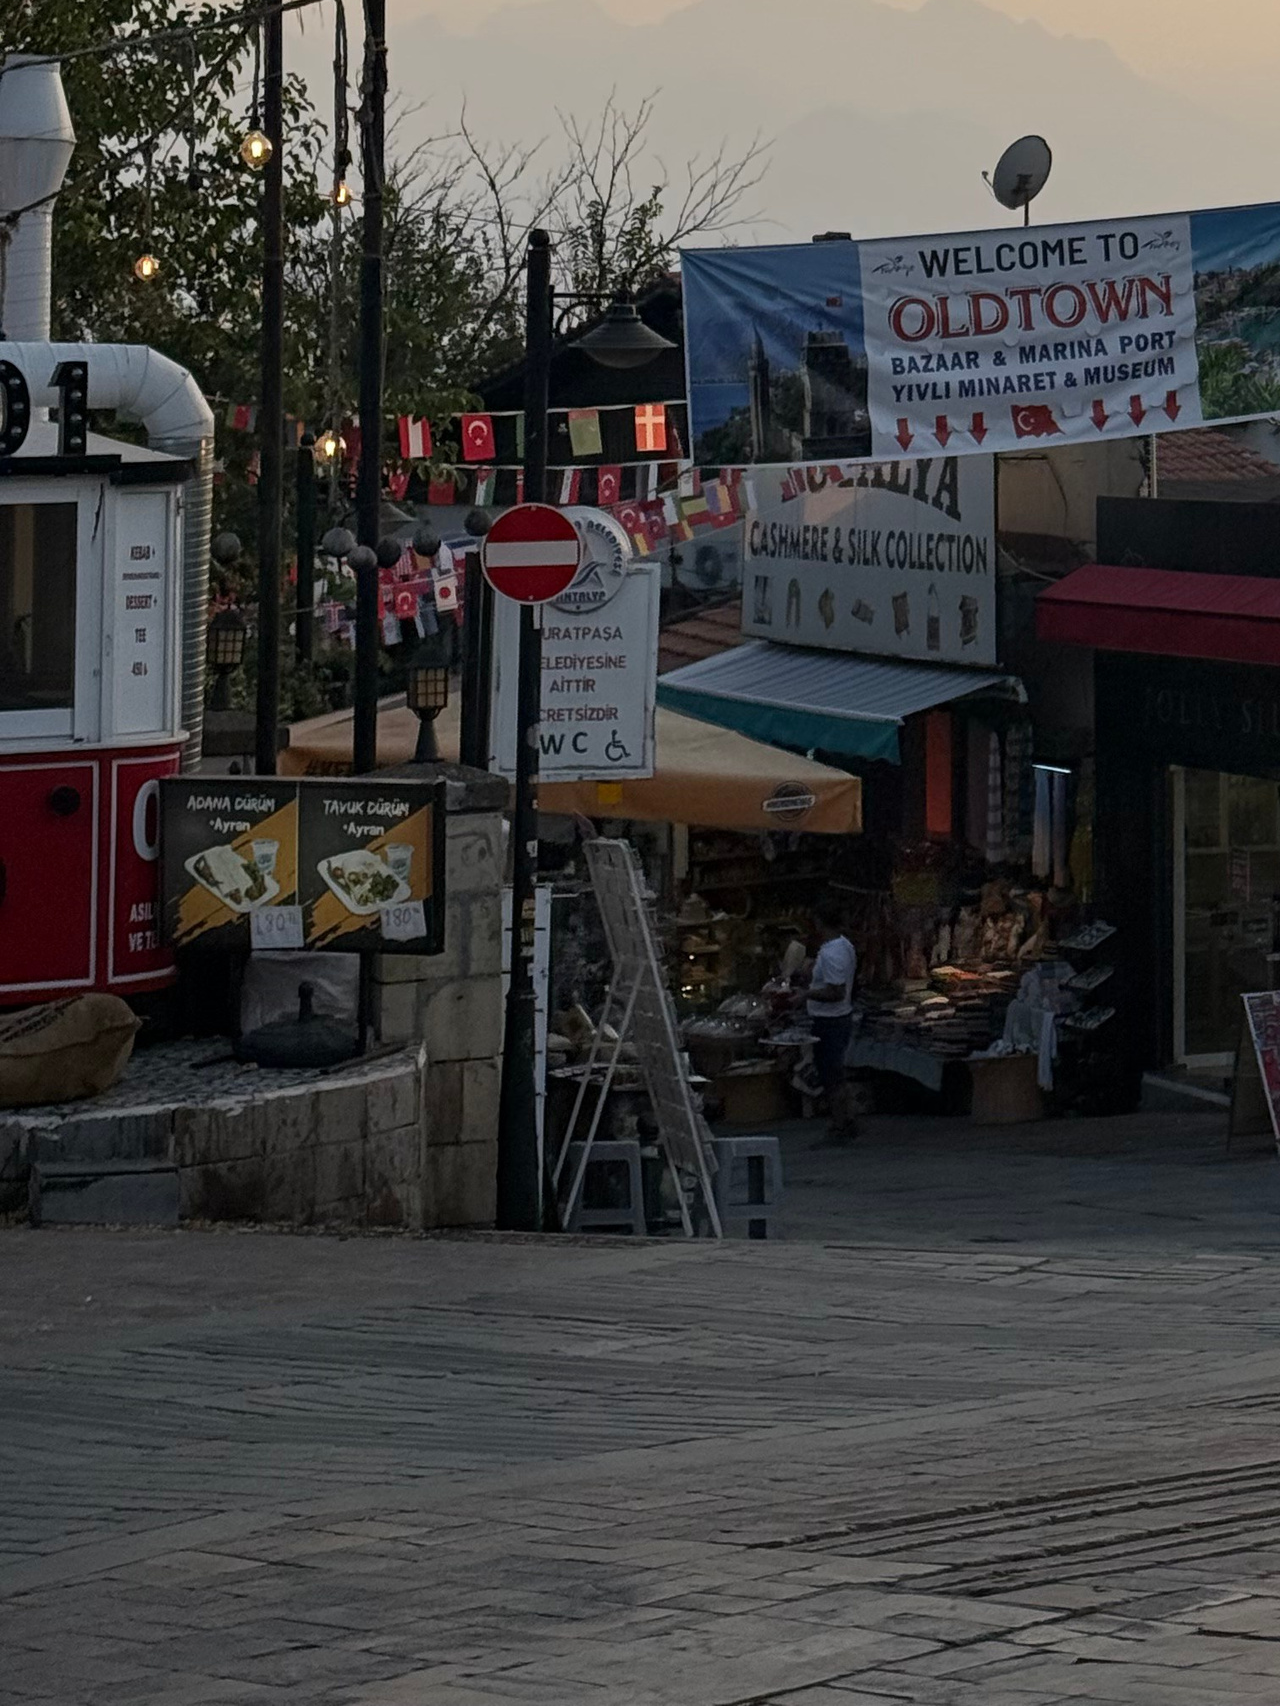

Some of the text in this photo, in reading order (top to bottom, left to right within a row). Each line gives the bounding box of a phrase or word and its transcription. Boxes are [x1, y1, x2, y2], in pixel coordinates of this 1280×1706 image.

[918, 232, 1139, 278] WELCOME TO
[888, 271, 1175, 342] OLDTOWN
[891, 330, 1176, 375] BAZAAR & MARINA PORT
[891, 356, 1176, 403] YIVLI MINARET & MUSEUM
[750, 520, 828, 562] CASHMERE
[832, 527, 843, 564] &
[885, 530, 987, 575] COLLECTION
[541, 626, 623, 642] URATPAŞA
[187, 795, 231, 810] ADANA
[323, 800, 364, 815] TAVUK
[213, 816, 250, 832] Ayran
[347, 822, 384, 837] Ayran
